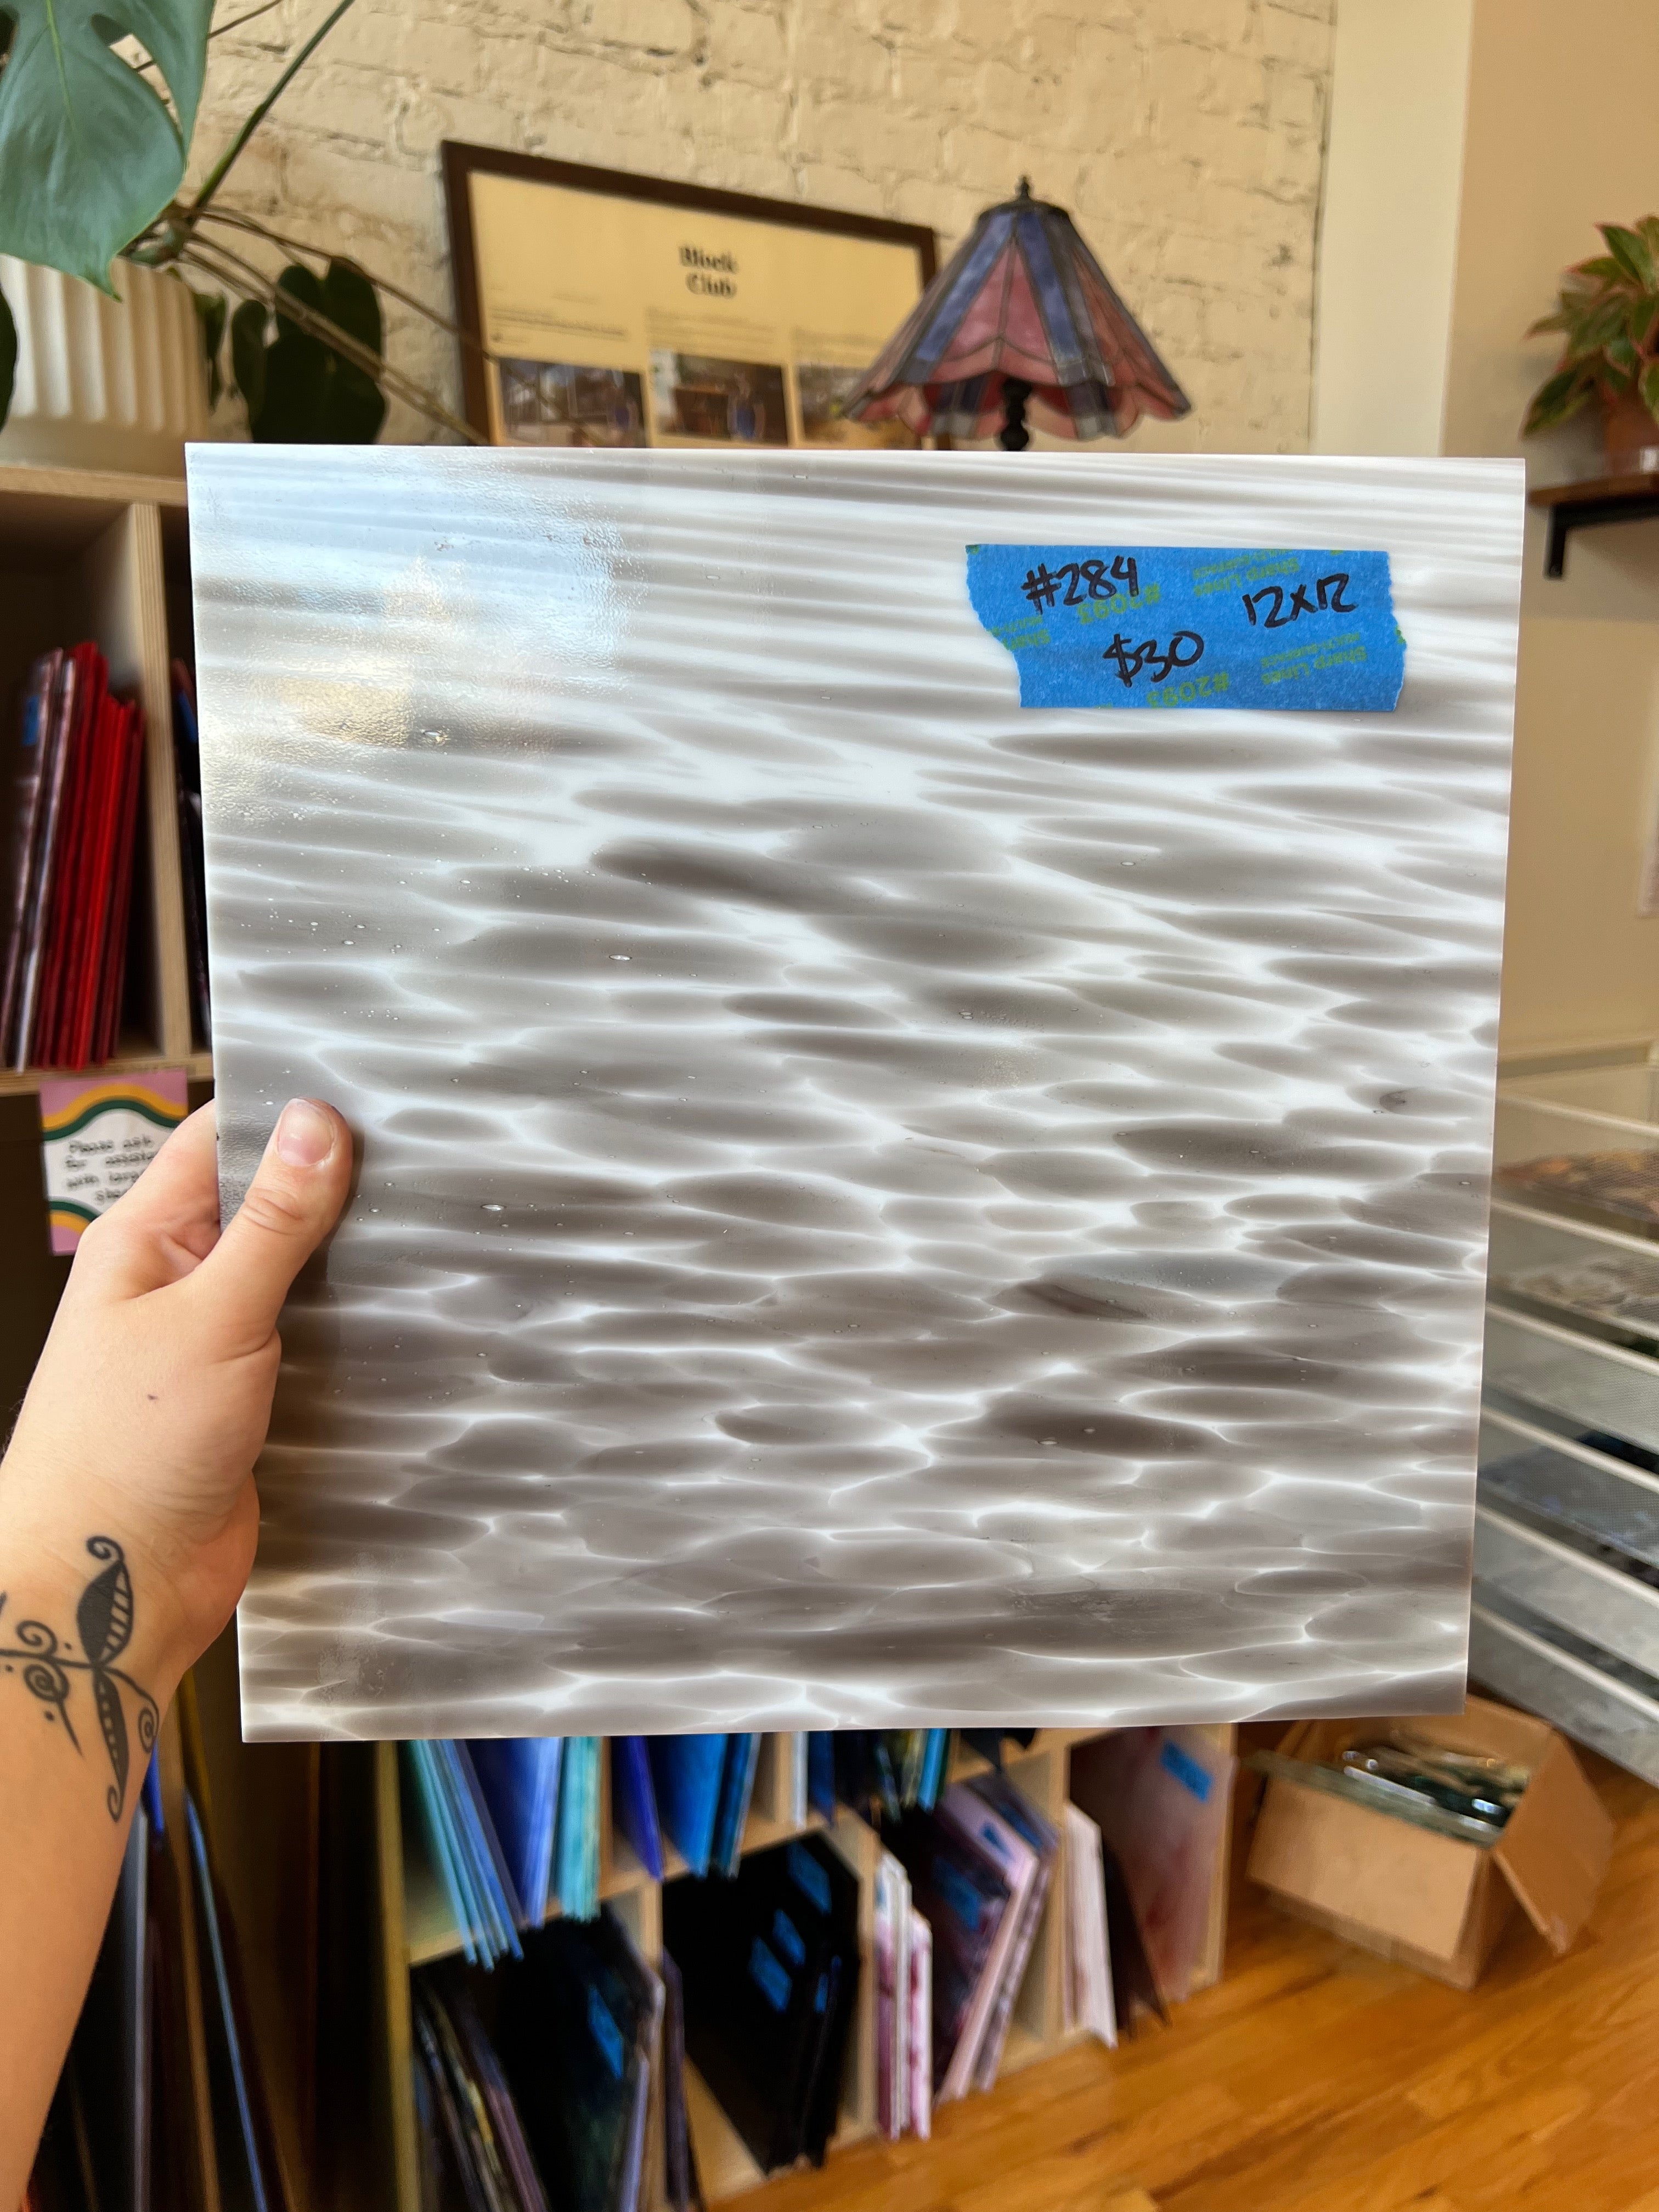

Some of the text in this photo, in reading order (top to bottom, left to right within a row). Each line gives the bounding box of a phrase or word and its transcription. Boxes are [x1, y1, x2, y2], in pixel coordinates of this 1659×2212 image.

[1020, 555, 1139, 615] #284
[1194, 557, 1300, 597] Sharp Lines
[1077, 582, 1160, 625] #2093
[1102, 631, 1205, 688] $30
[1262, 646, 1368, 686] Sharp Lines
[1147, 672, 1229, 709] #2093
